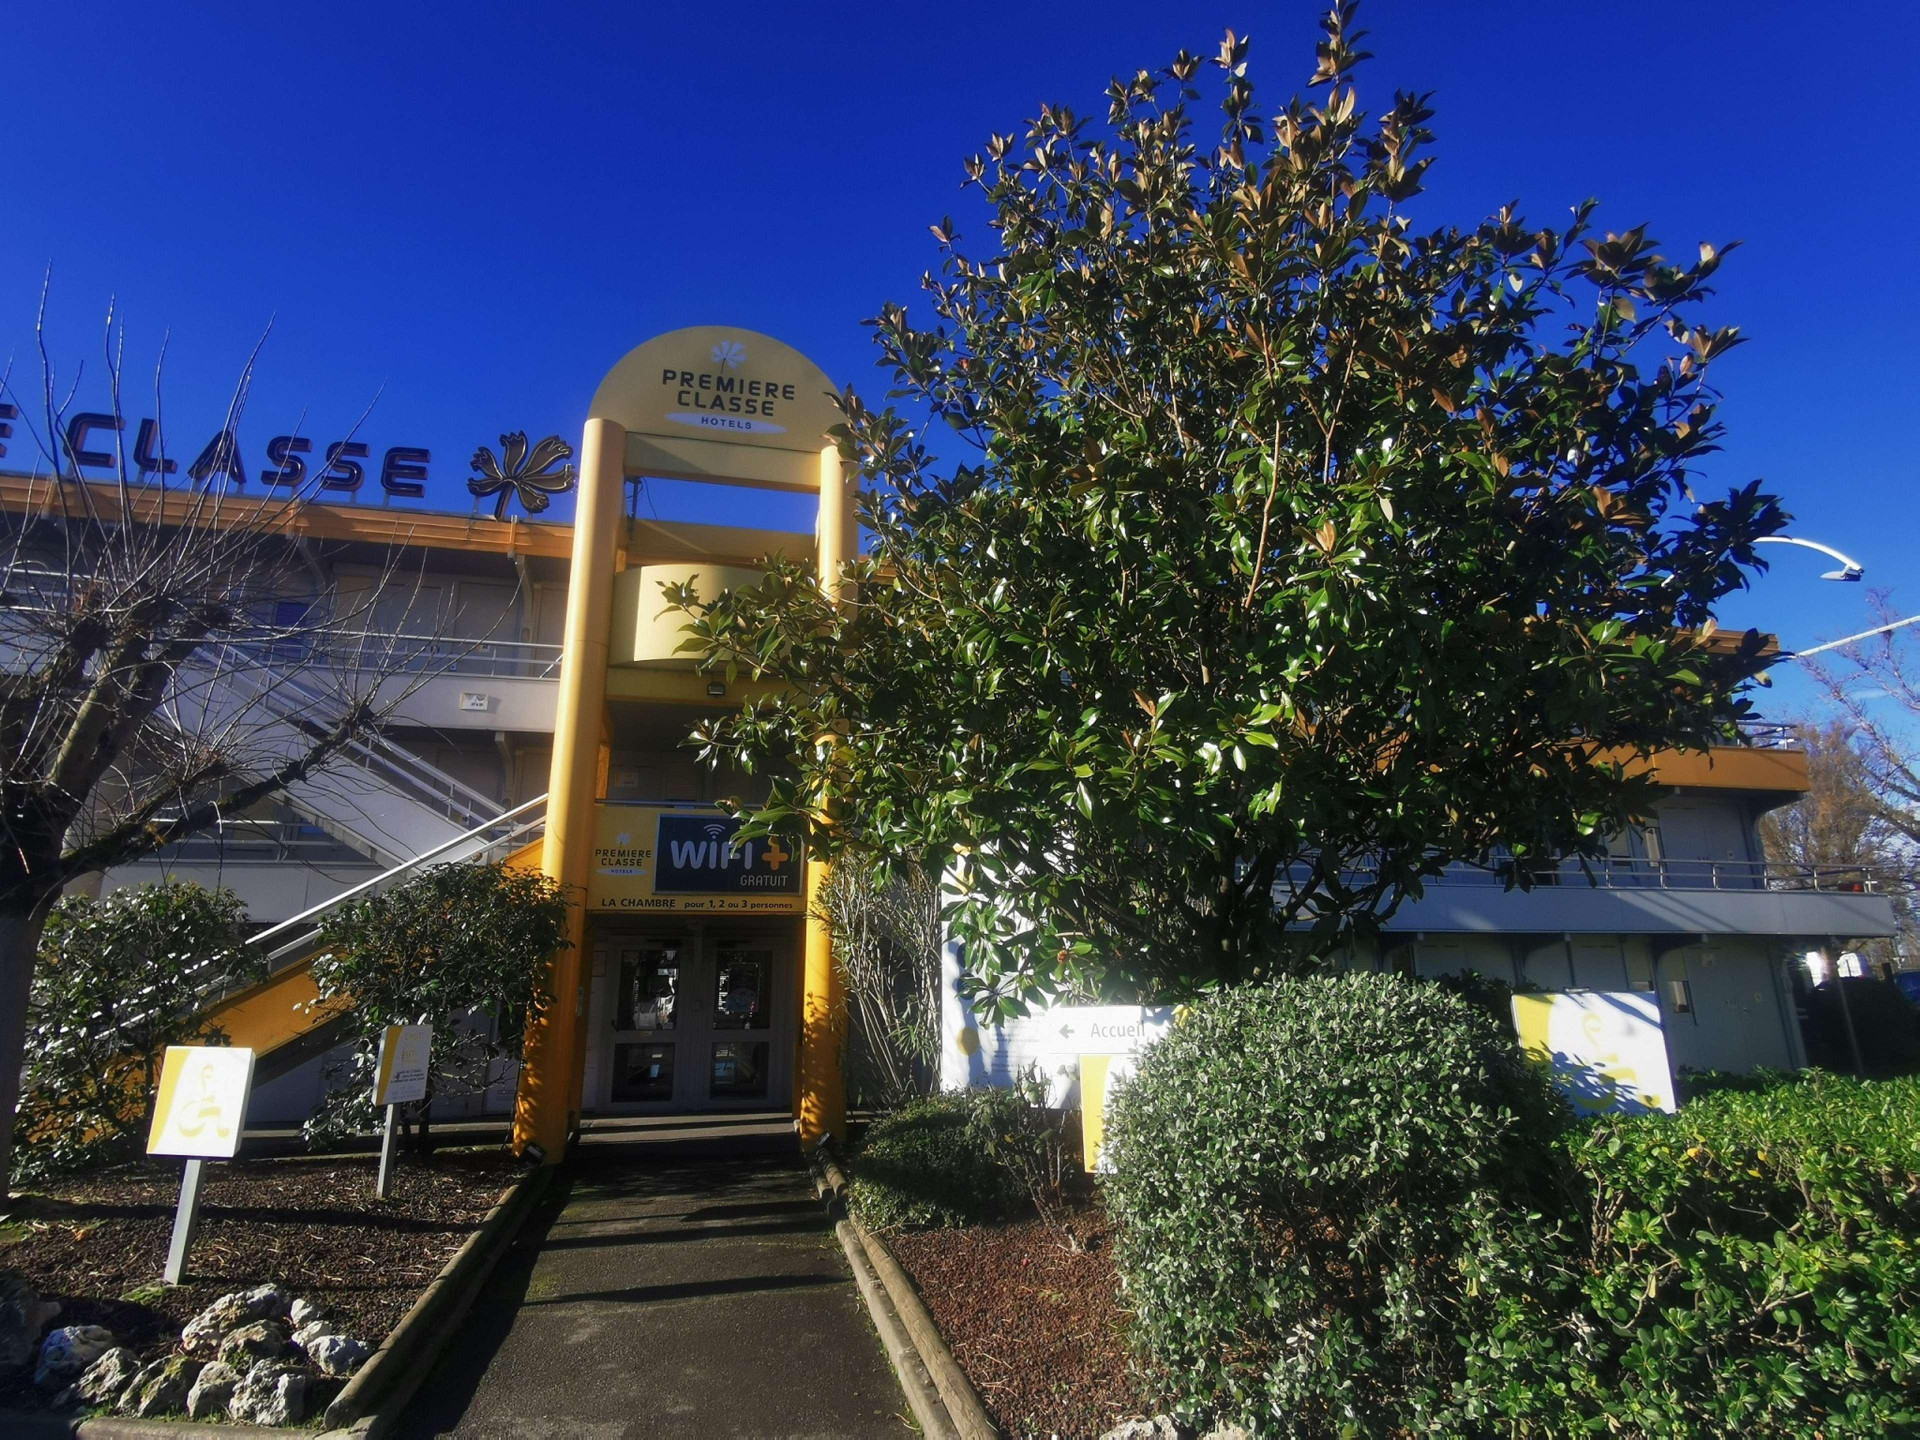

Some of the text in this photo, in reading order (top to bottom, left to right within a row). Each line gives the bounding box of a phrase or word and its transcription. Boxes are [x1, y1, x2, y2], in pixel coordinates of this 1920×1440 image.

[662, 369, 796, 400] PREMIERE
[677, 390, 775, 417] CLASSE
[701, 416, 752, 430] HOTELS
[63, 412, 431, 498] CLASSE
[594, 848, 652, 858] PREMIERE
[601, 857, 643, 867] CLASSE
[740, 874, 789, 887] GRATUIT
[601, 898, 617, 907] LA
[620, 898, 676, 909] CHAMBRE
[718, 900, 725, 908] 2
[741, 900, 748, 909] 3
[1090, 1019, 1146, 1039] Accueil
